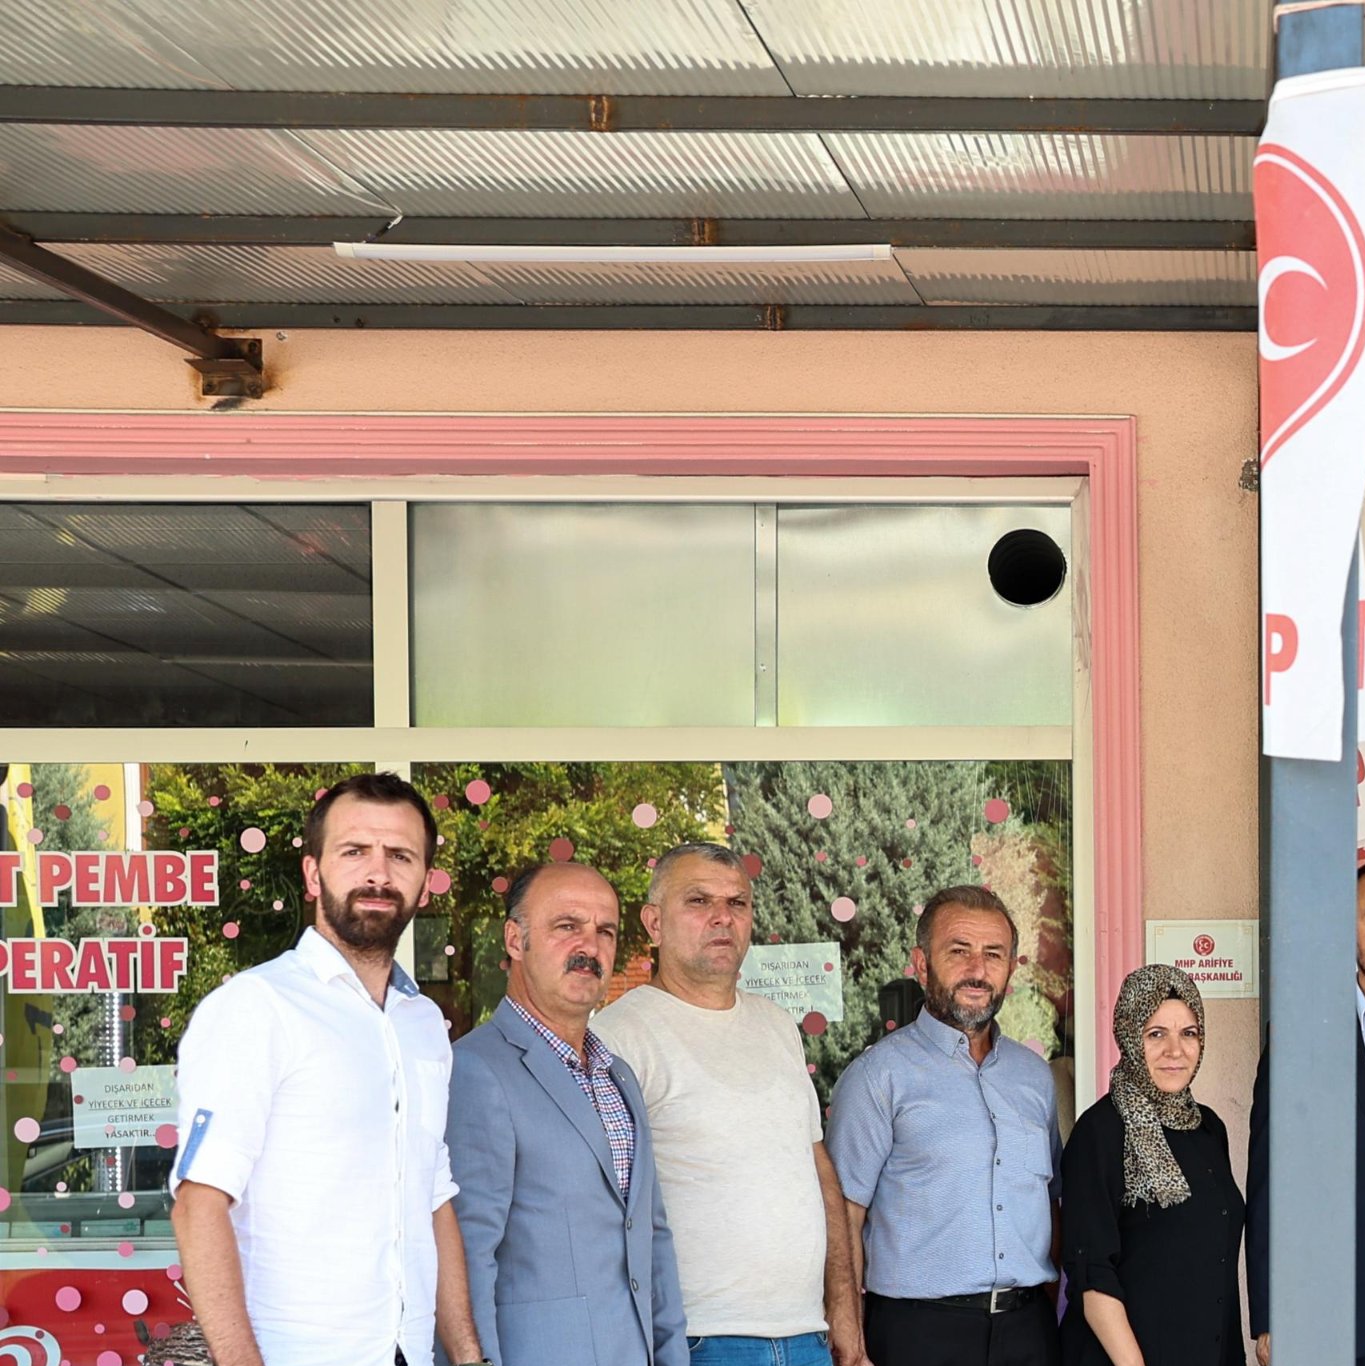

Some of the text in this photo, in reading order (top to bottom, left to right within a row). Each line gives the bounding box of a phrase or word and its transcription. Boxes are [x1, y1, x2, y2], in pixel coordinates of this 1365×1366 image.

[36, 850, 220, 907] PEMBE
[0, 922, 188, 994] ERATİF
[1174, 957, 1234, 968] MHP ARİFİYE
[104, 1083, 154, 1094] DIŞARIDAN
[88, 1099, 125, 1110] YİYECEK
[126, 1099, 139, 1108] VE
[107, 1114, 155, 1123] GETİRMEK
